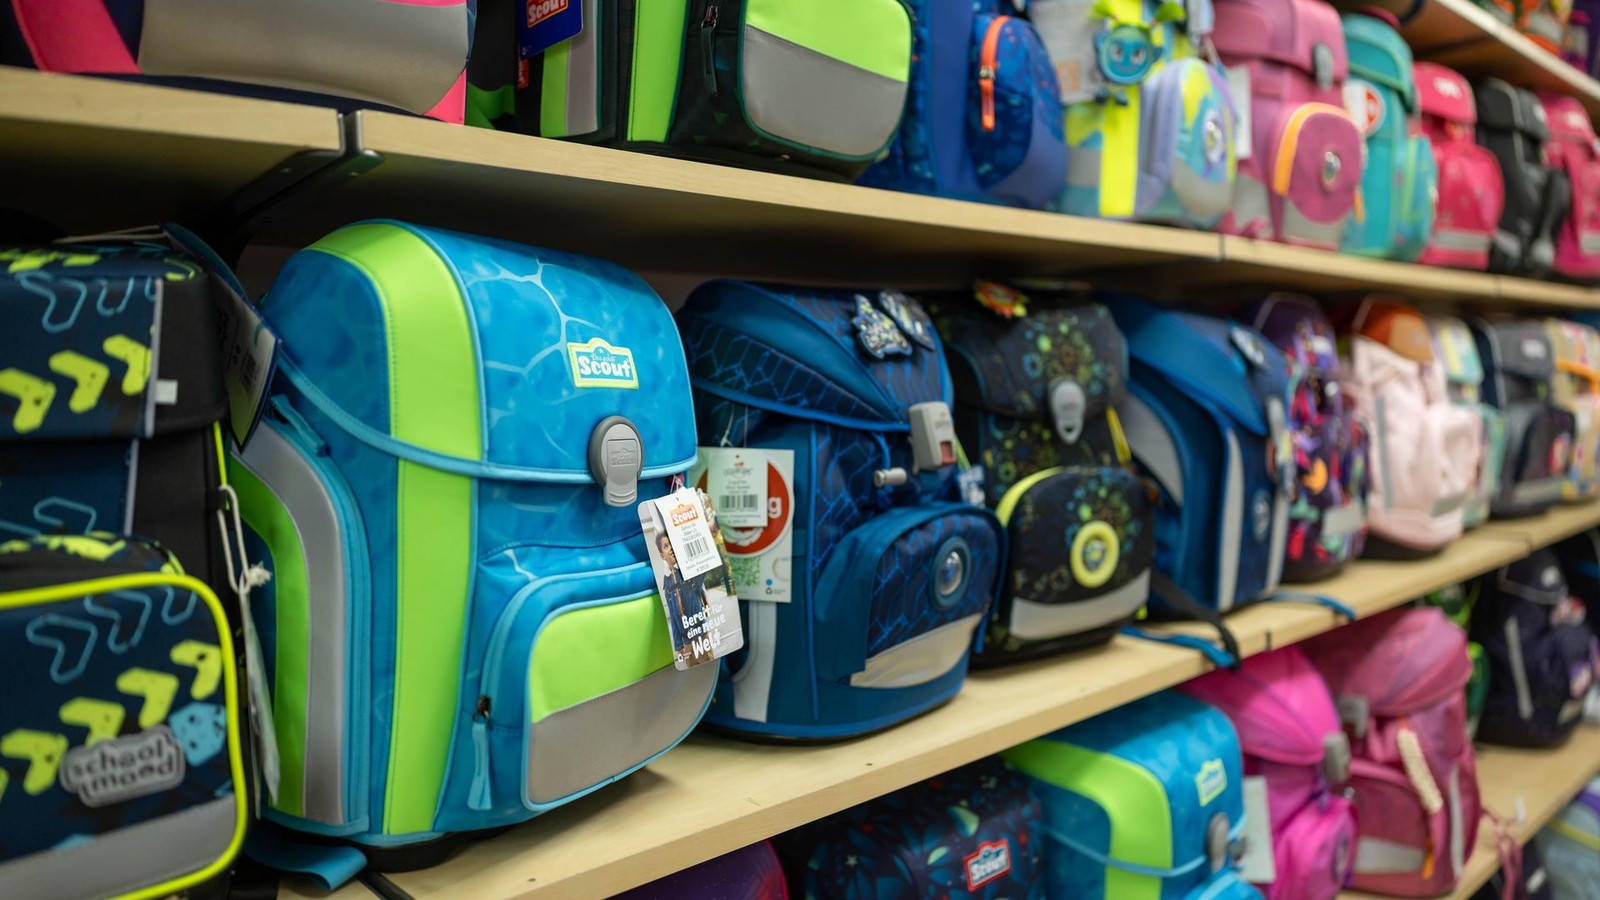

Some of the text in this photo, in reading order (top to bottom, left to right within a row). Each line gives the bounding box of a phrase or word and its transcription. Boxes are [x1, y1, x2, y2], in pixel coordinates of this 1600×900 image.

[578, 355, 631, 378] Scout
[672, 507, 698, 525] Scout
[681, 604, 711, 630] Bereit
[687, 613, 726, 639] eine neue
[692, 628, 721, 659] Welt
